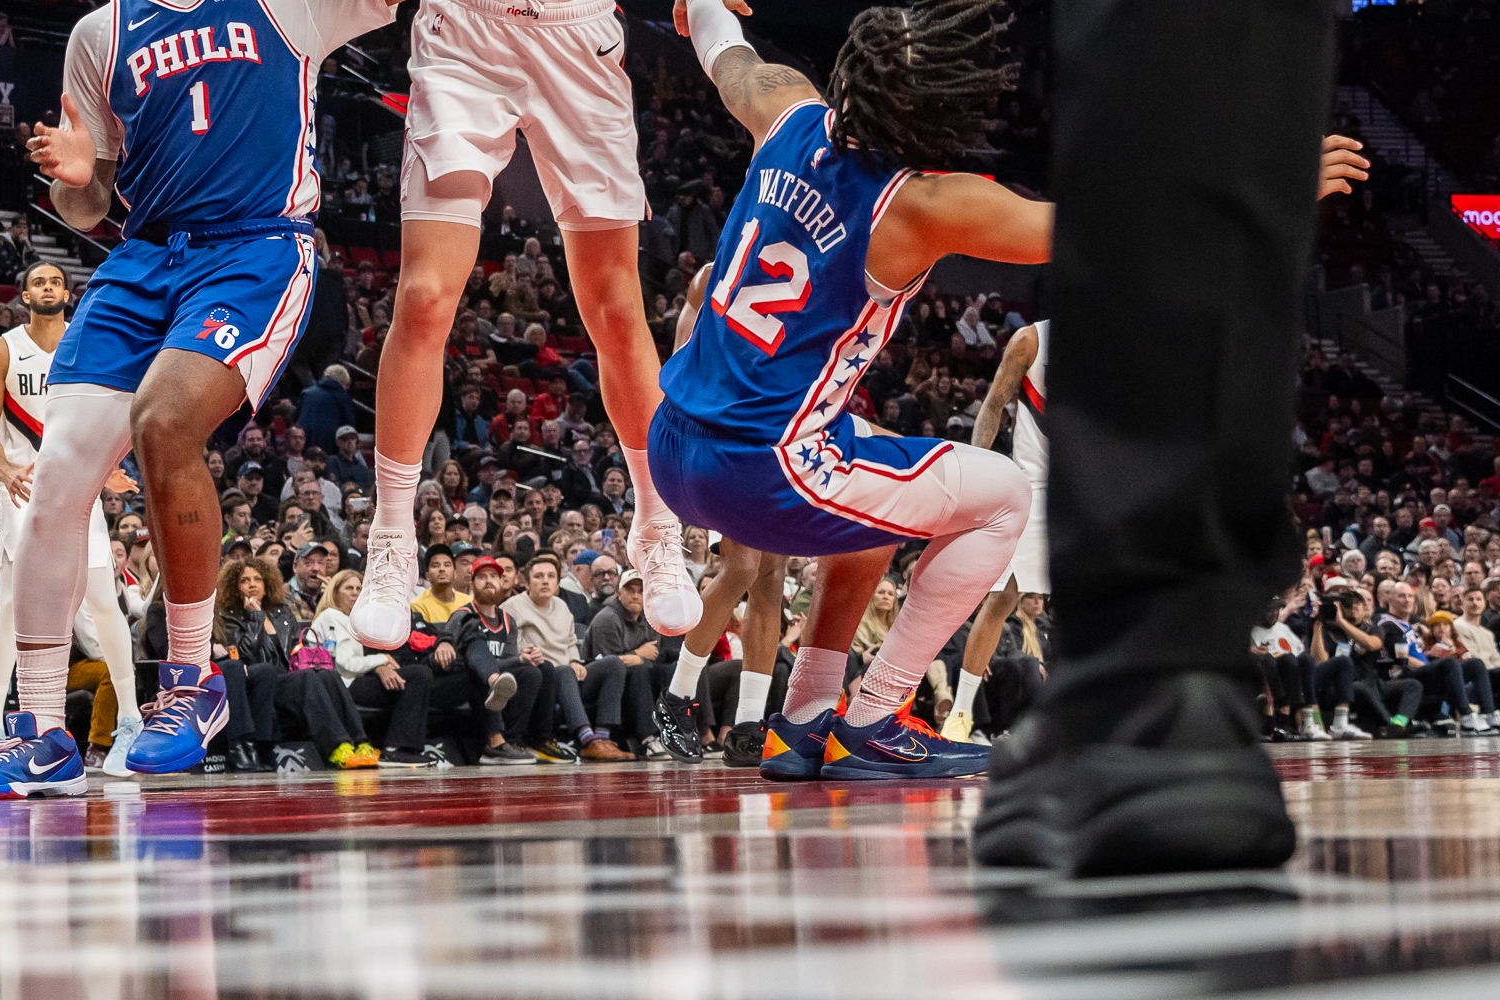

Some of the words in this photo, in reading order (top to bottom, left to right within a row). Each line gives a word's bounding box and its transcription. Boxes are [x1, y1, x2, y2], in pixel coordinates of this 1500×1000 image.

[506, 5, 539, 20] ripcity
[126, 21, 262, 98] PHILA
[189, 81, 211, 135] 1
[757, 168, 847, 254] WATFORD
[711, 217, 812, 357] 12
[194, 317, 240, 350] 76
